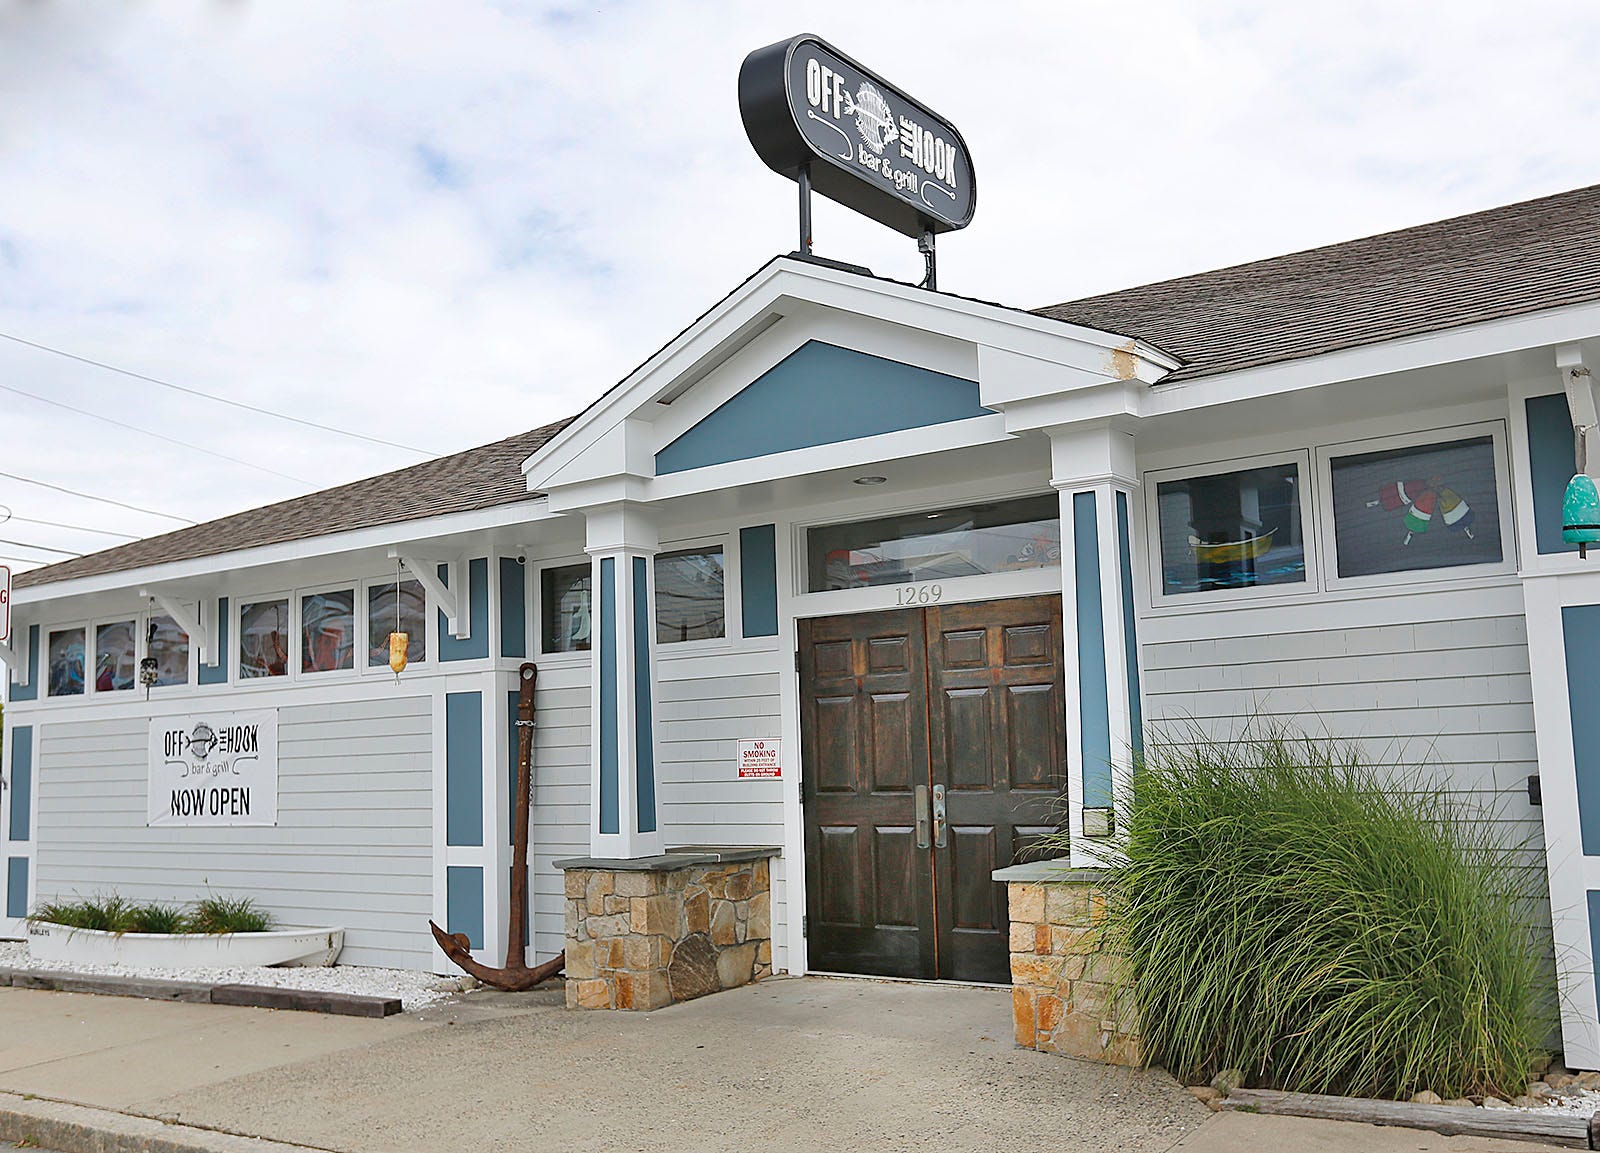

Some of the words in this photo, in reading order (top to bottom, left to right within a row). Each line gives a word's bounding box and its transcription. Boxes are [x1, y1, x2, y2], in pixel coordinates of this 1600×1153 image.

[807, 58, 844, 119] OFF
[899, 114, 914, 159] THE
[858, 143, 882, 172] bar
[882, 160, 894, 179] &
[894, 167, 918, 194] grill
[912, 123, 957, 188] HOOK
[896, 585, 942, 606] 1269
[165, 731, 184, 757] OFF
[219, 727, 227, 753] THE
[227, 724, 259, 753] HOOK
[743, 750, 776, 758] SMOKING
[192, 763, 204, 775] bar
[205, 762, 211, 773] &
[212, 761, 229, 777] grill
[171, 789, 206, 816] NOW
[209, 787, 250, 816] OPEN
